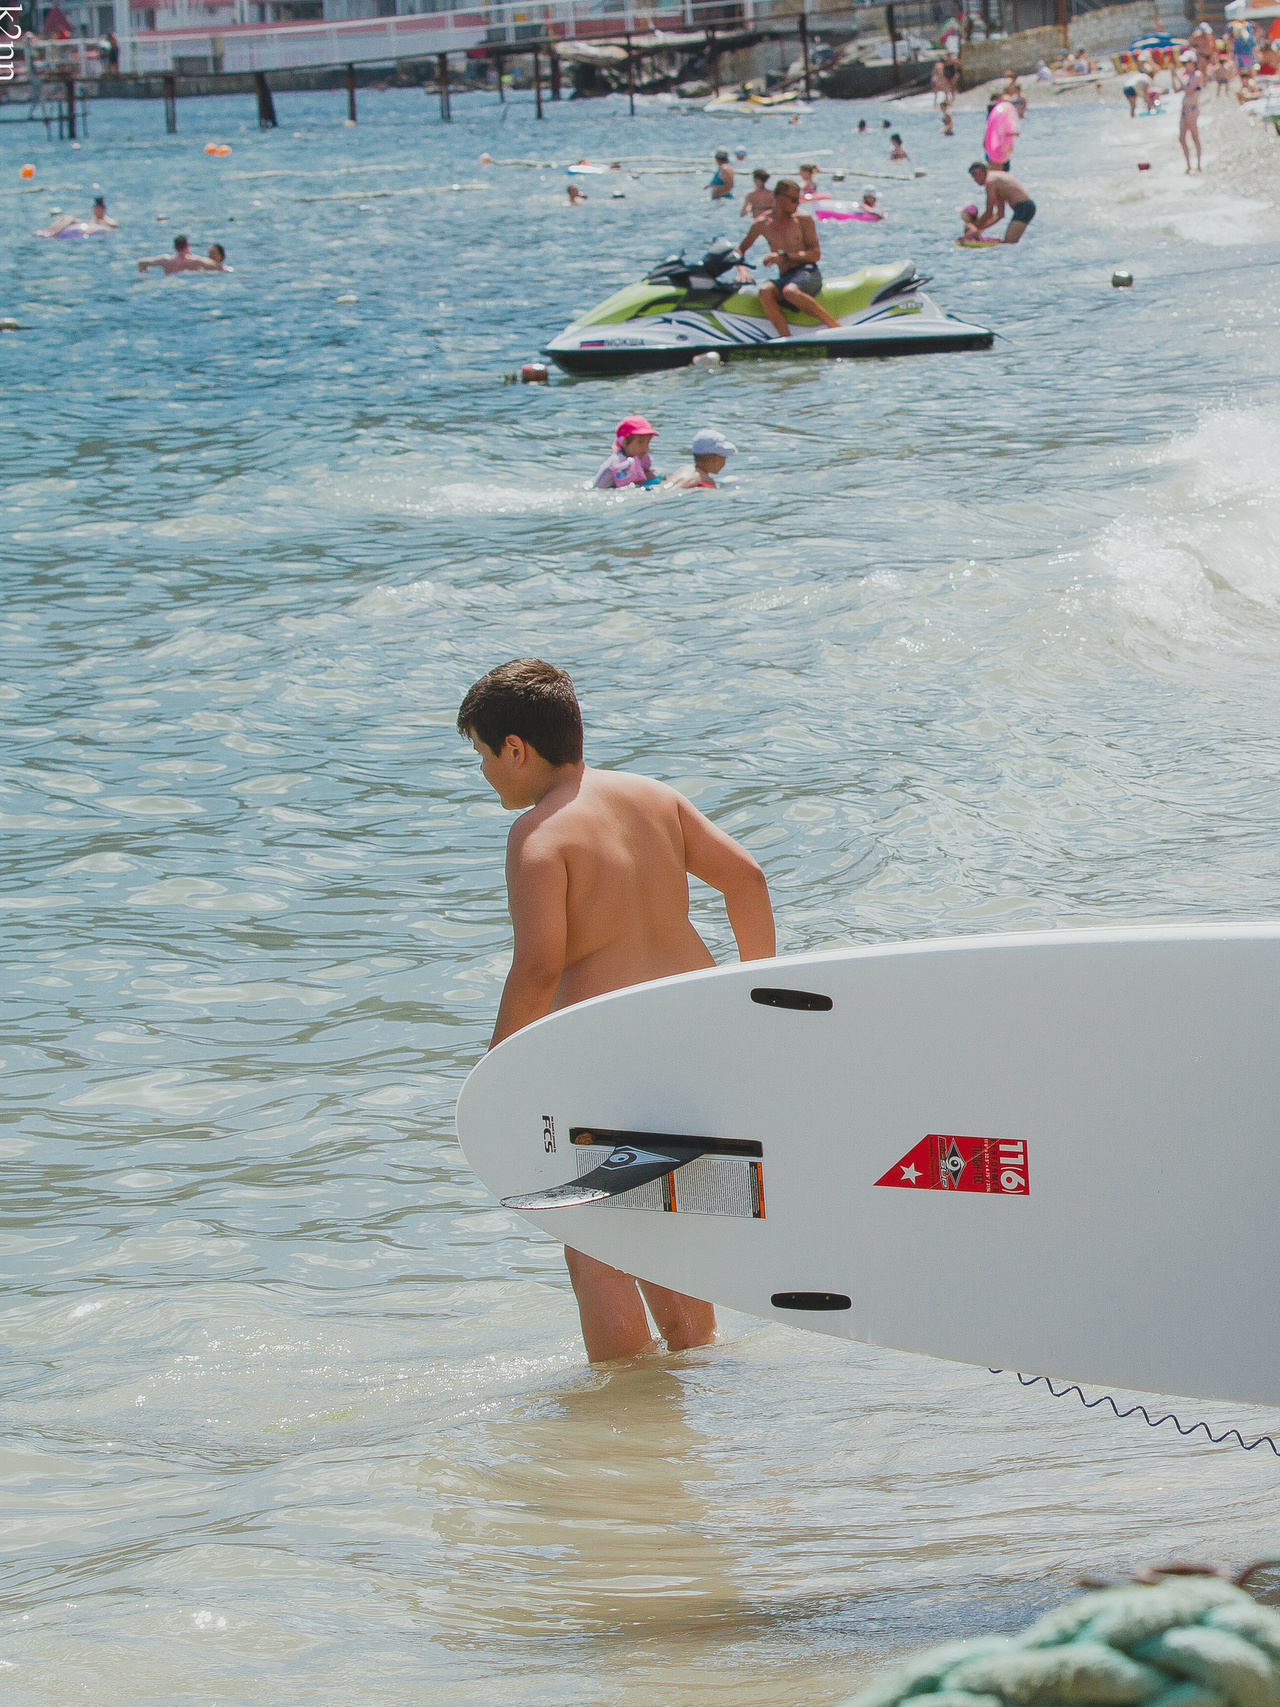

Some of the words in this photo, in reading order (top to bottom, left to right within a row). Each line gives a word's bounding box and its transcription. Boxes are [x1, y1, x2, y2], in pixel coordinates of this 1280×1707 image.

[542, 1115, 554, 1153] FCS
[972, 1146, 984, 1185] TOUGH-TEC
[990, 1139, 999, 1193] PERFORMER
